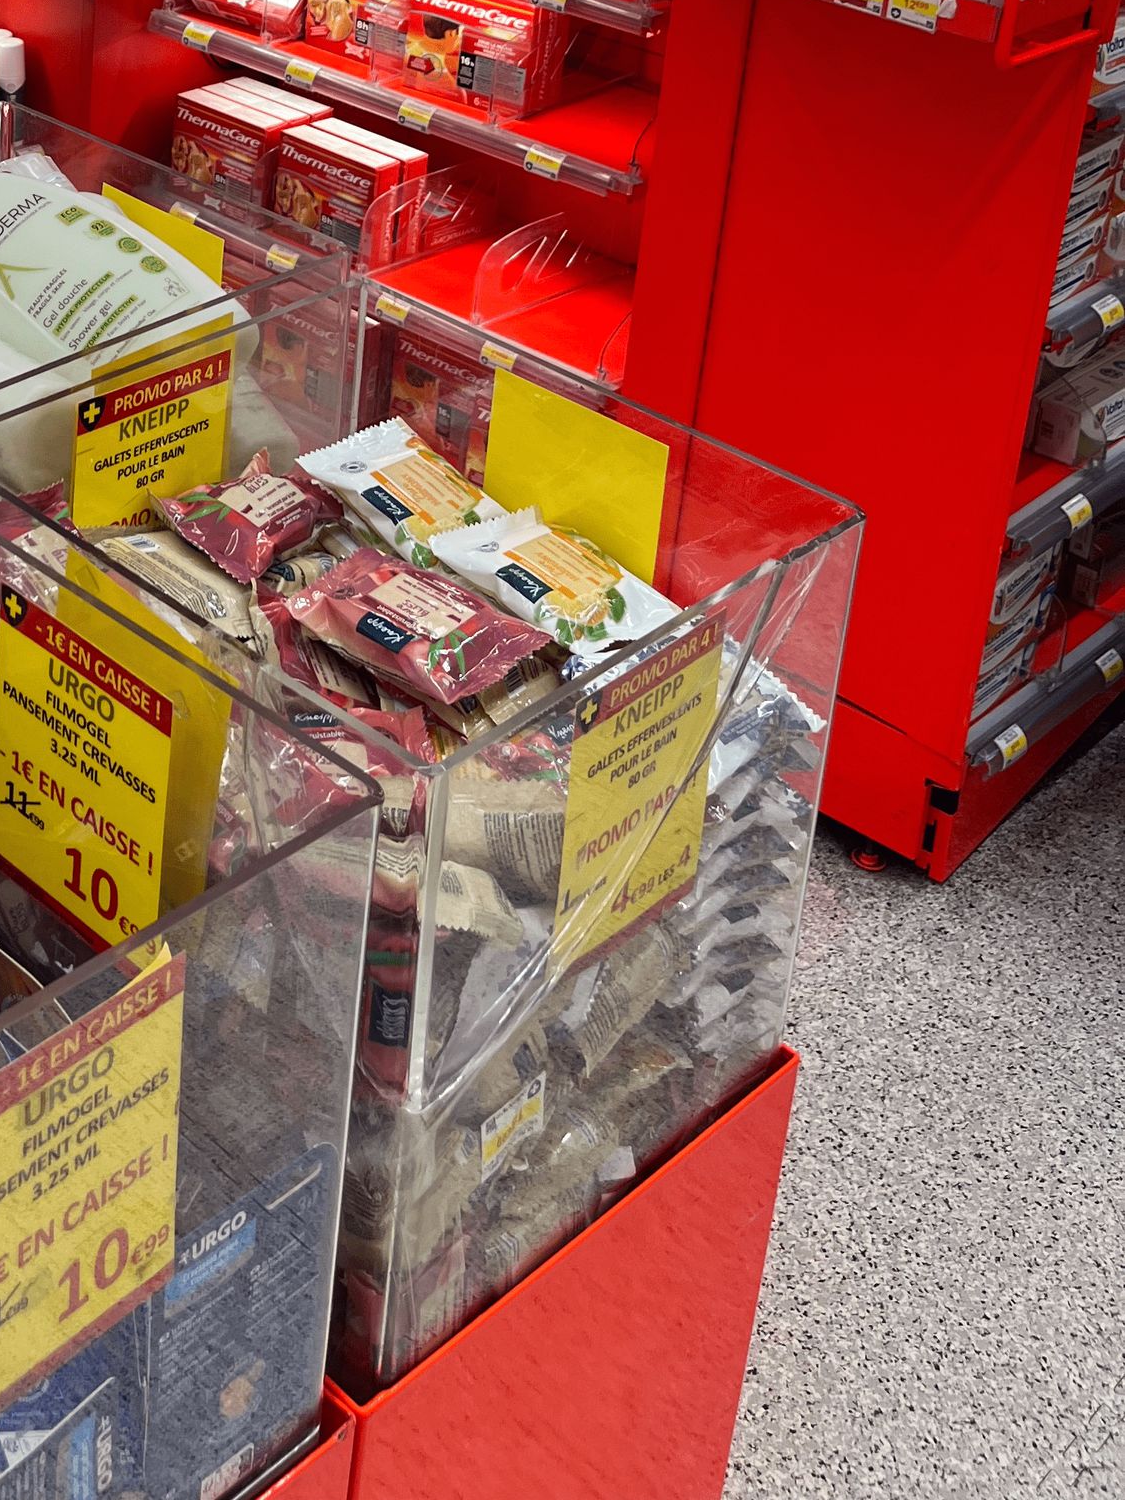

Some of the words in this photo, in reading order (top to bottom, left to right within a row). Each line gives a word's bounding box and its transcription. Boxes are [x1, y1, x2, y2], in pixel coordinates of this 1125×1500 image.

[177, 107, 261, 149] ThermaCare
[43, 310, 59, 328] Gel
[58, 278, 88, 311] douche
[115, 380, 170, 414] PROMO
[175, 370, 201, 392] PAR
[205, 363, 213, 379] 4
[94, 449, 131, 472] GALETS
[134, 419, 209, 457] EFFERVESCENTS
[119, 398, 189, 442] KNEIPP
[118, 462, 145, 480] POUR
[149, 455, 158, 467] LE
[161, 445, 185, 462] BAIN
[136, 476, 147, 488] 80
[151, 470, 164, 482] GR
[48, 657, 116, 722] URGO
[613, 674, 683, 738] KNEIPP
[3, 681, 79, 745] PANSEMENT
[82, 740, 156, 804] CREVASSES
[46, 690, 112, 748] FILMOGEL
[20, 1048, 115, 1126] URGO
[76, 1067, 170, 1146] CREVASSES
[21, 1086, 113, 1159] FILMOGEL
[18, 1220, 56, 1267] EN
[64, 1147, 152, 1231] CAISSE
